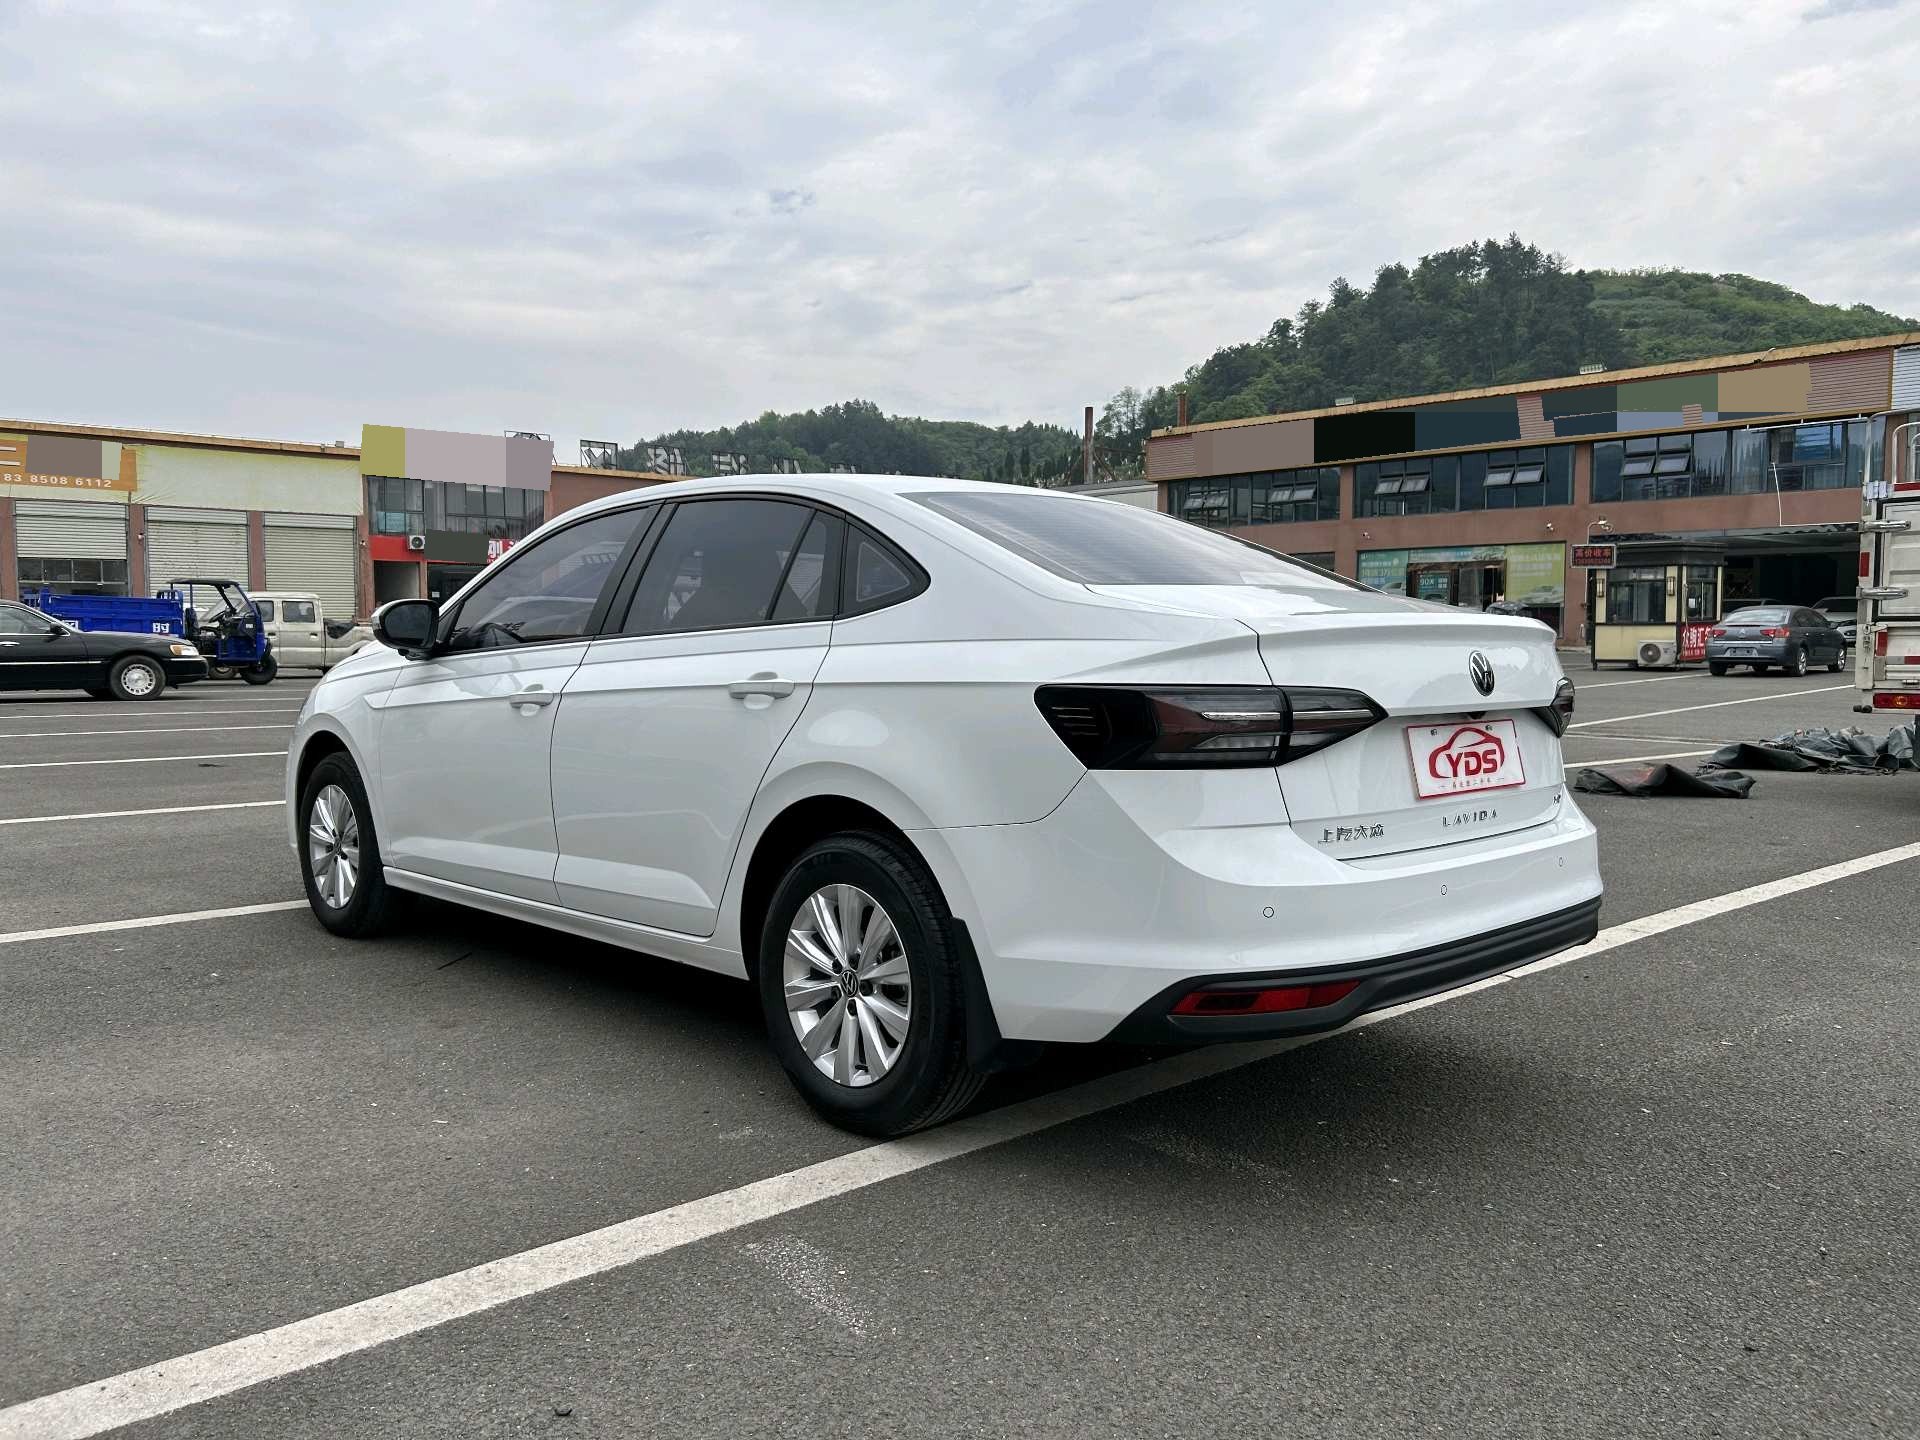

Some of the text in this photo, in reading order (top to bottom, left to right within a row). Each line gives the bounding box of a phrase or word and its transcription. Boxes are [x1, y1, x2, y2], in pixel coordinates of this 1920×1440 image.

[30, 474, 68, 485] 8508
[75, 478, 112, 488] 6112
[1445, 749, 1498, 777] YDS
[1442, 808, 1499, 827] LAVIDA
[1318, 823, 1385, 843] 上汽大众
